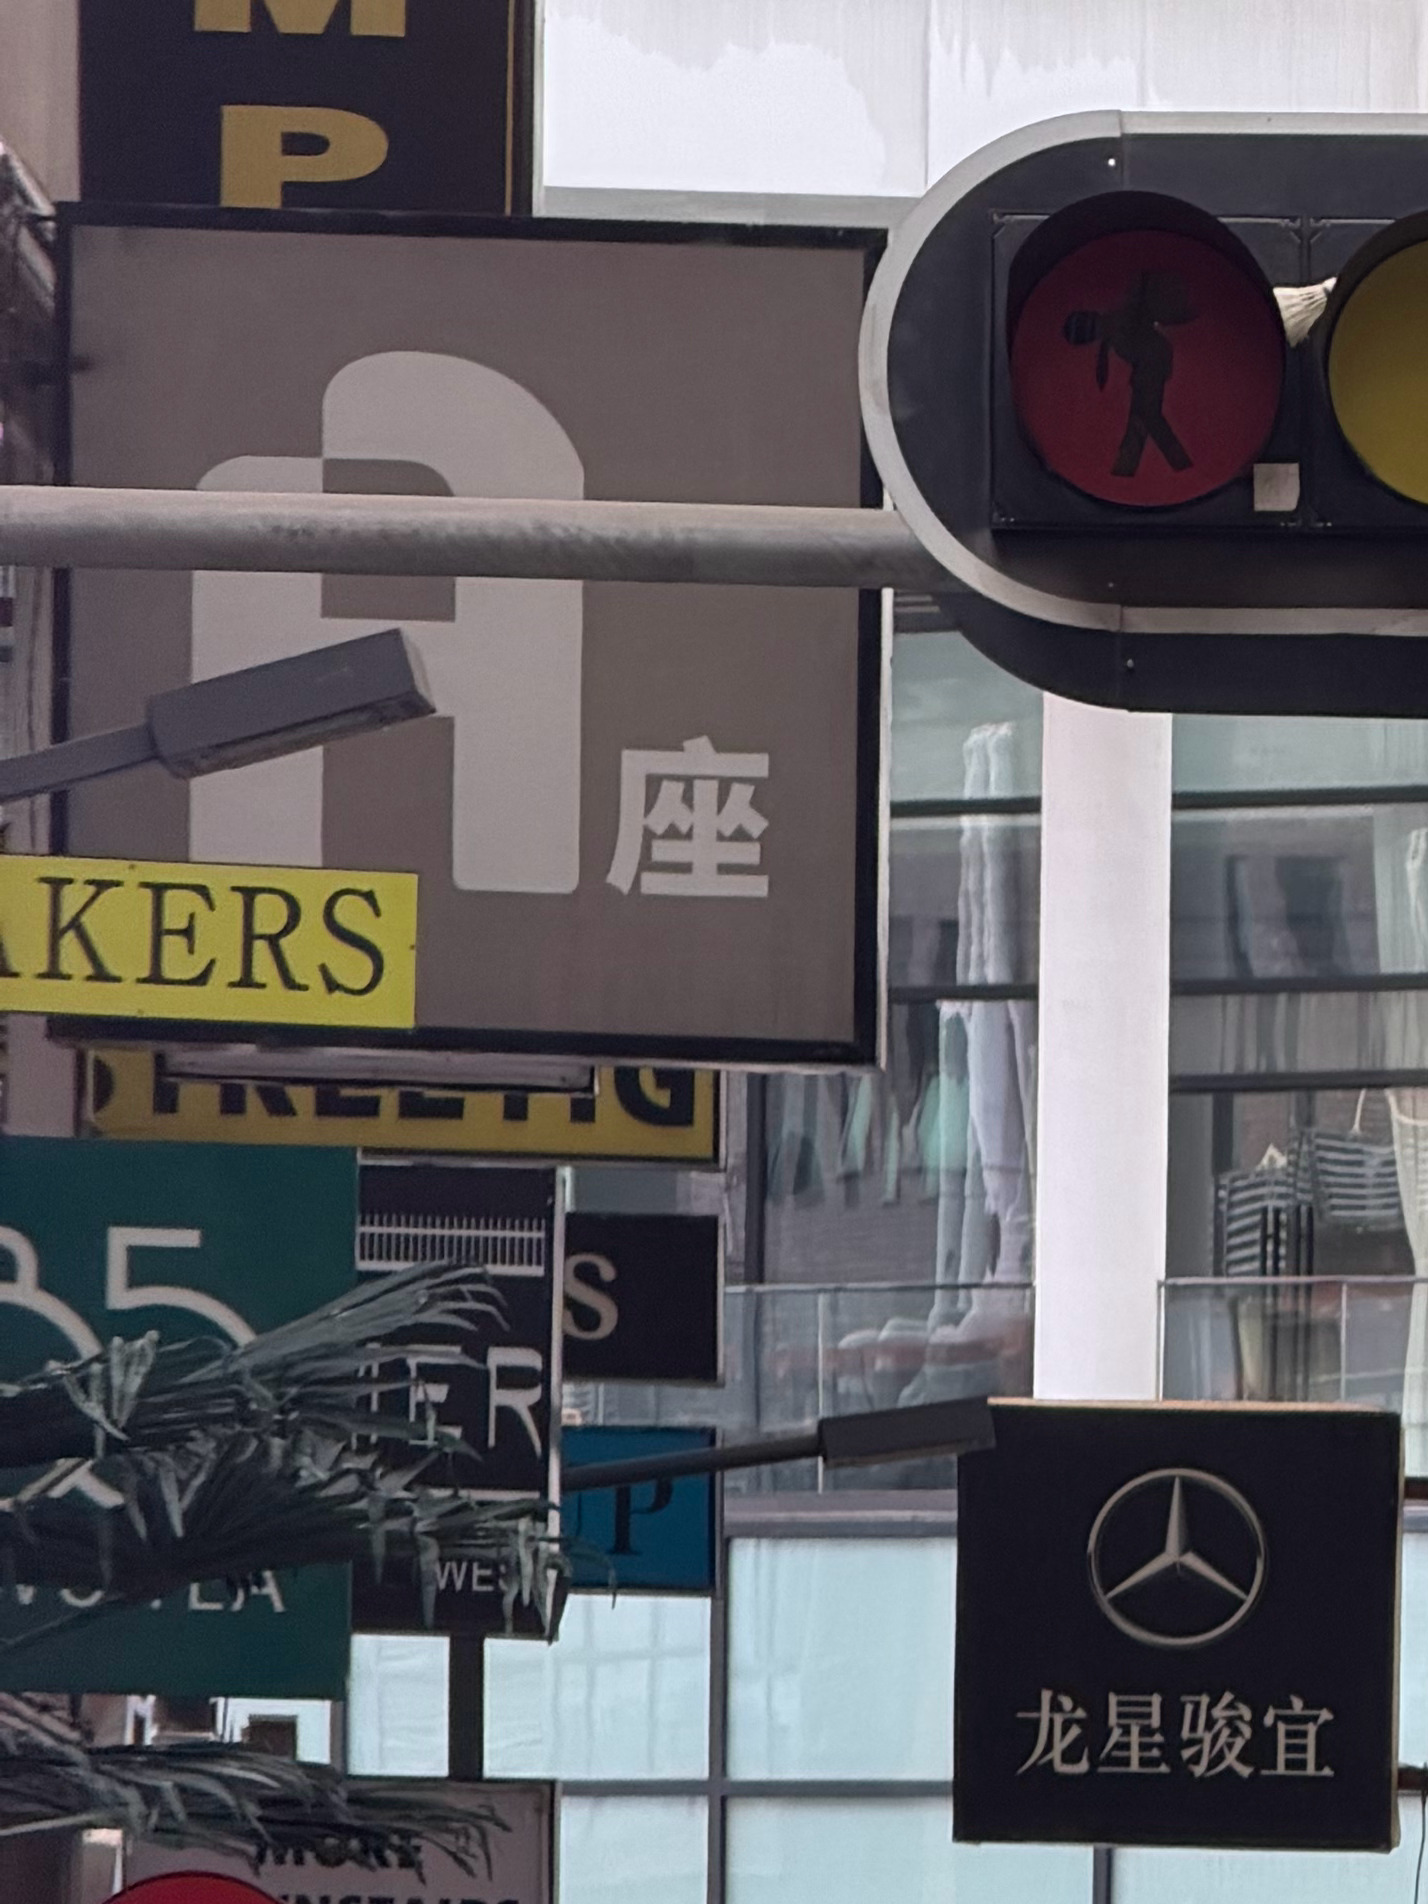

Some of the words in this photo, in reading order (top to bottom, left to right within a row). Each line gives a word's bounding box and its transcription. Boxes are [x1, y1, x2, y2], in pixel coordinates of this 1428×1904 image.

[606, 735, 770, 899] 座
[0, 874, 387, 998] KERS
[1015, 1687, 1335, 1779] 龙星骏宜
